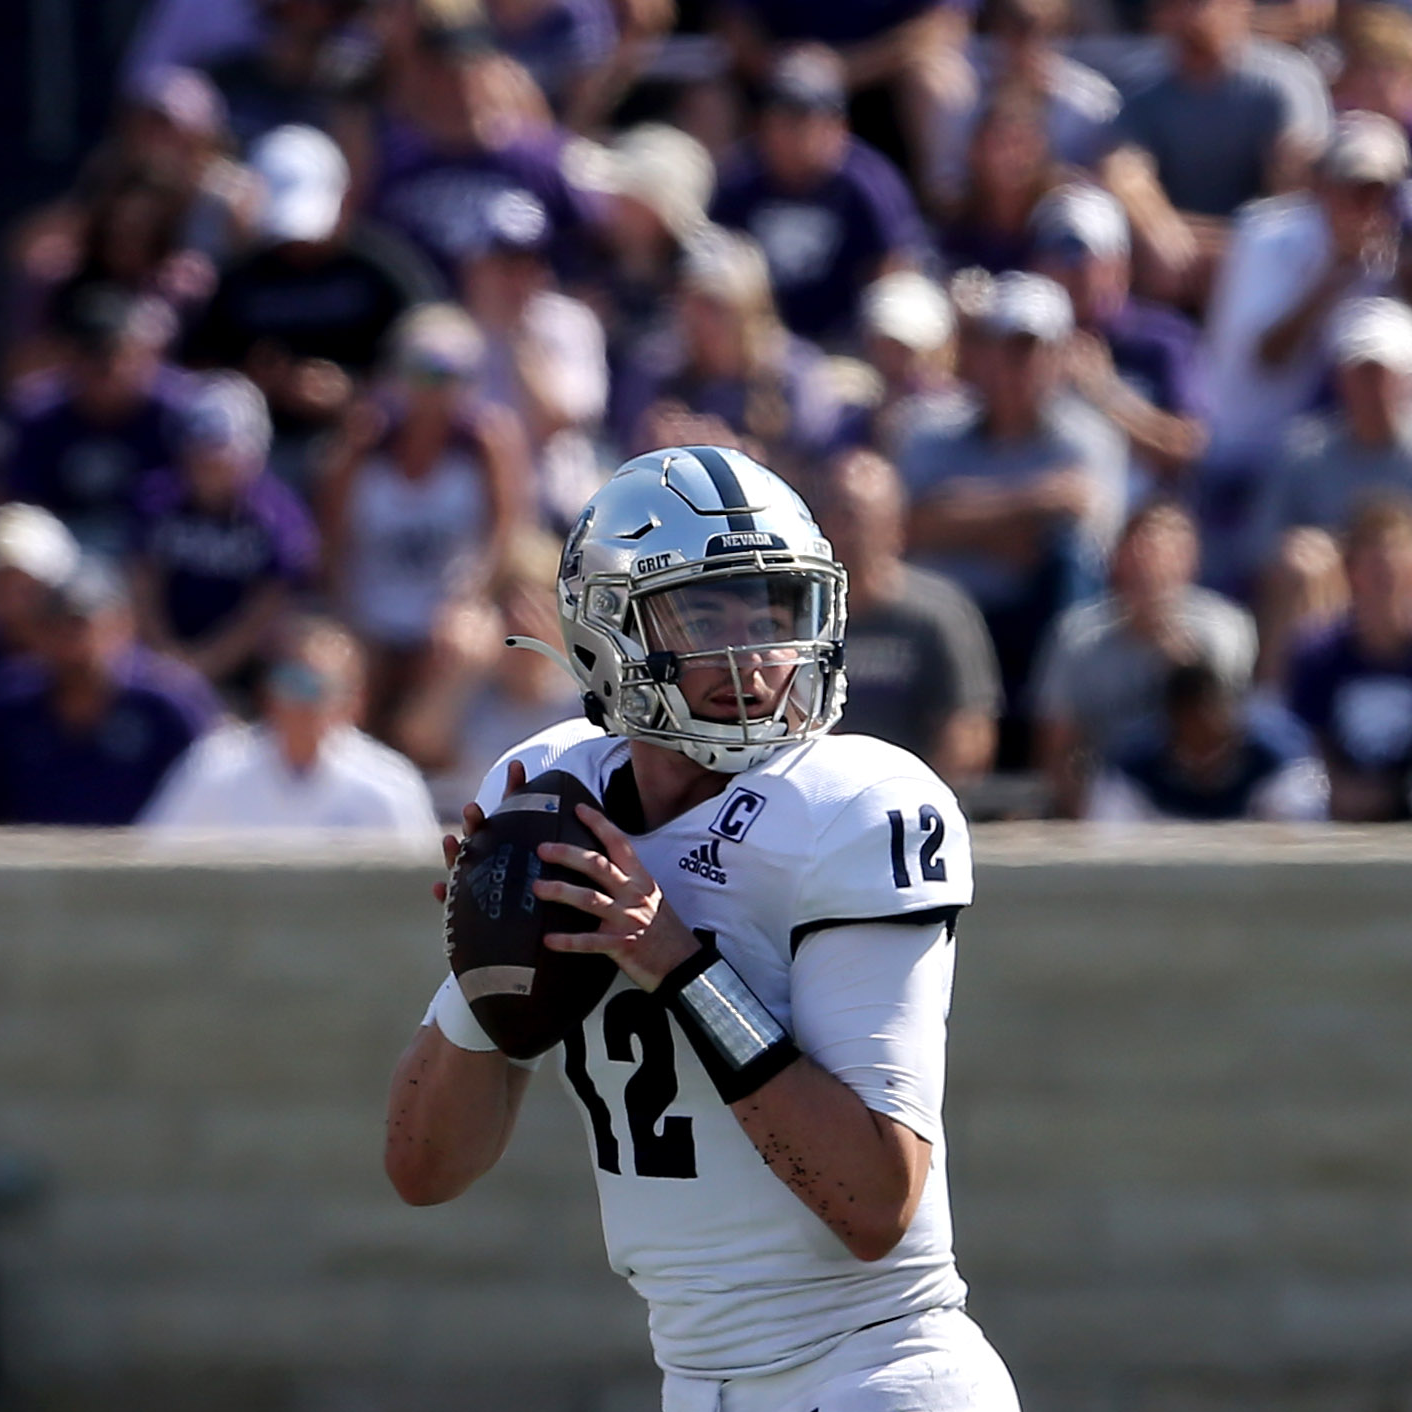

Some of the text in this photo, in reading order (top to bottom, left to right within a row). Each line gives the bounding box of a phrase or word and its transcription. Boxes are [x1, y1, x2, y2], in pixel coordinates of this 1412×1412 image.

[722, 533, 773, 548] NEVADA
[637, 553, 672, 574] GRIT
[720, 794, 758, 836] C
[887, 804, 947, 889] 12
[678, 856, 727, 885] adidas
[562, 988, 698, 1179] 12
